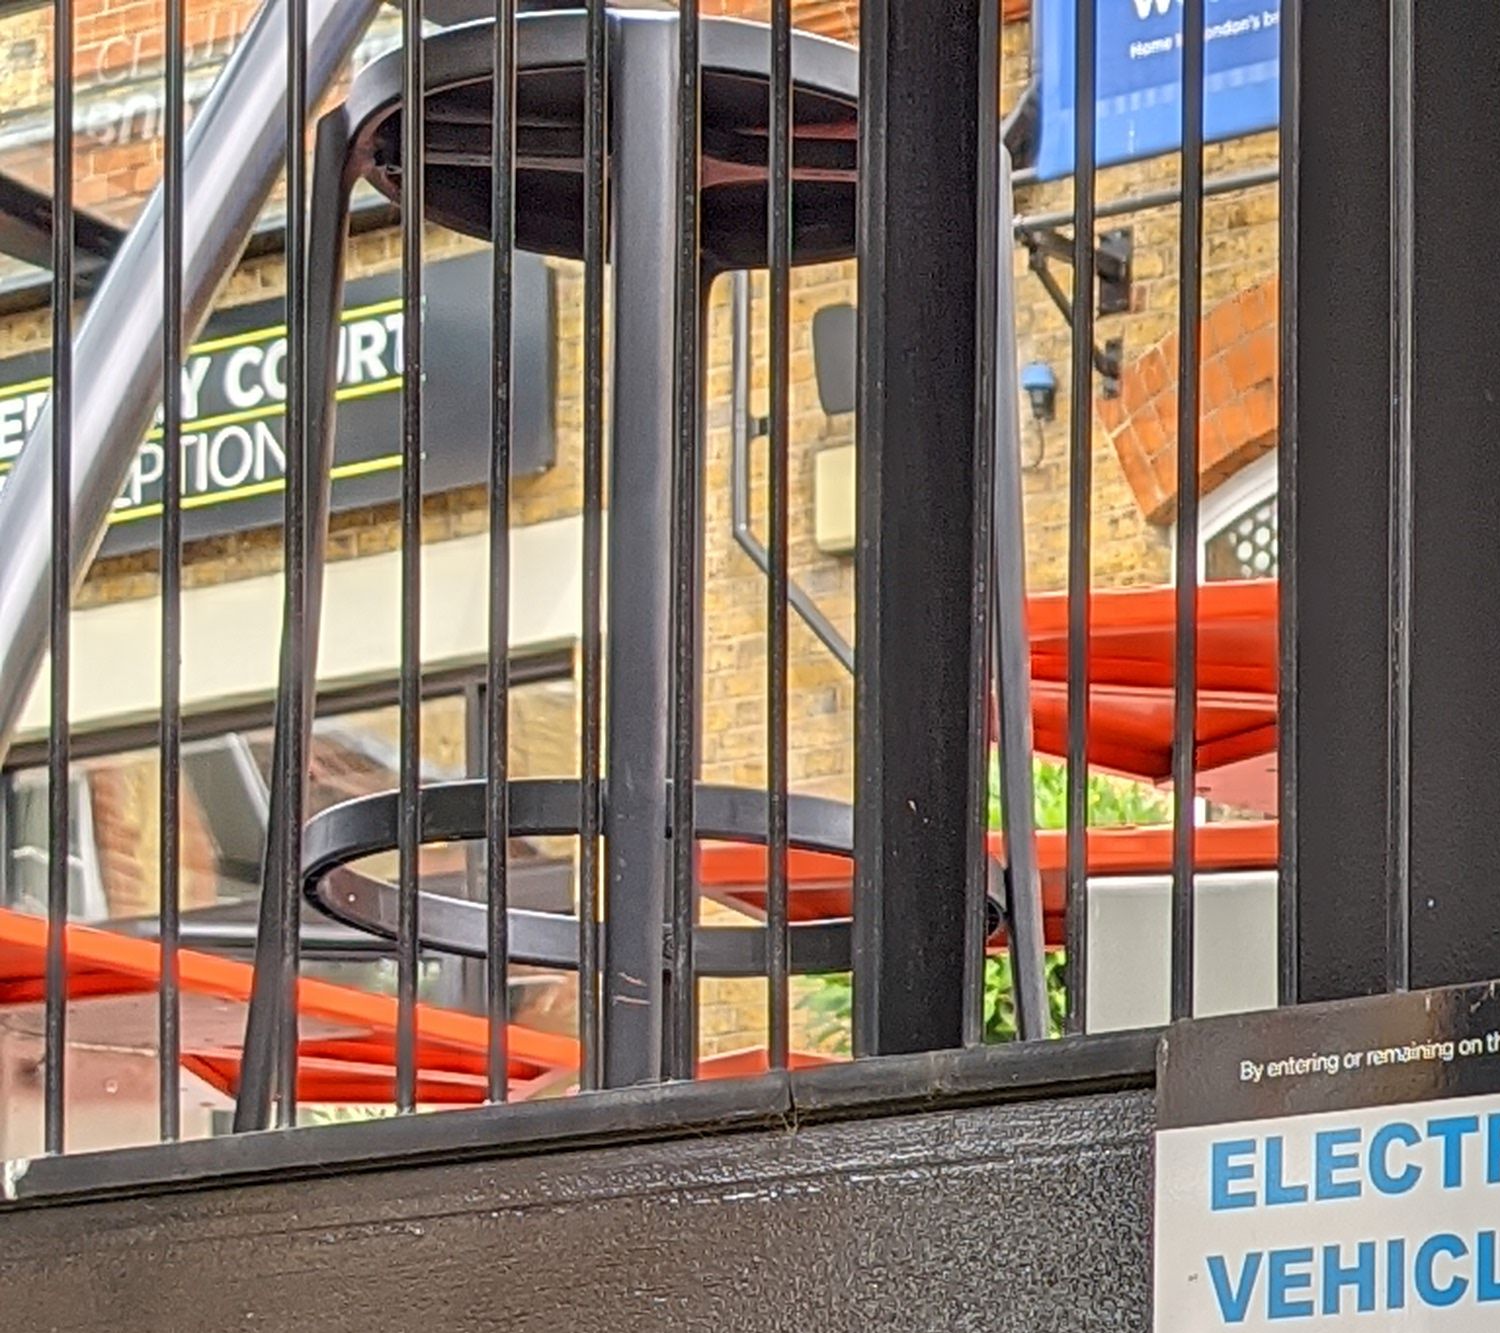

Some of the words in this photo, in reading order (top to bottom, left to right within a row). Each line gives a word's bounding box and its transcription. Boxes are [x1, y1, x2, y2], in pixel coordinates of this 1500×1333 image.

[1239, 1059, 1265, 1084] By
[1266, 1050, 1341, 1077] entering
[1341, 1052, 1364, 1070] or
[1365, 1038, 1455, 1067] remaining
[1458, 1037, 1483, 1057] on
